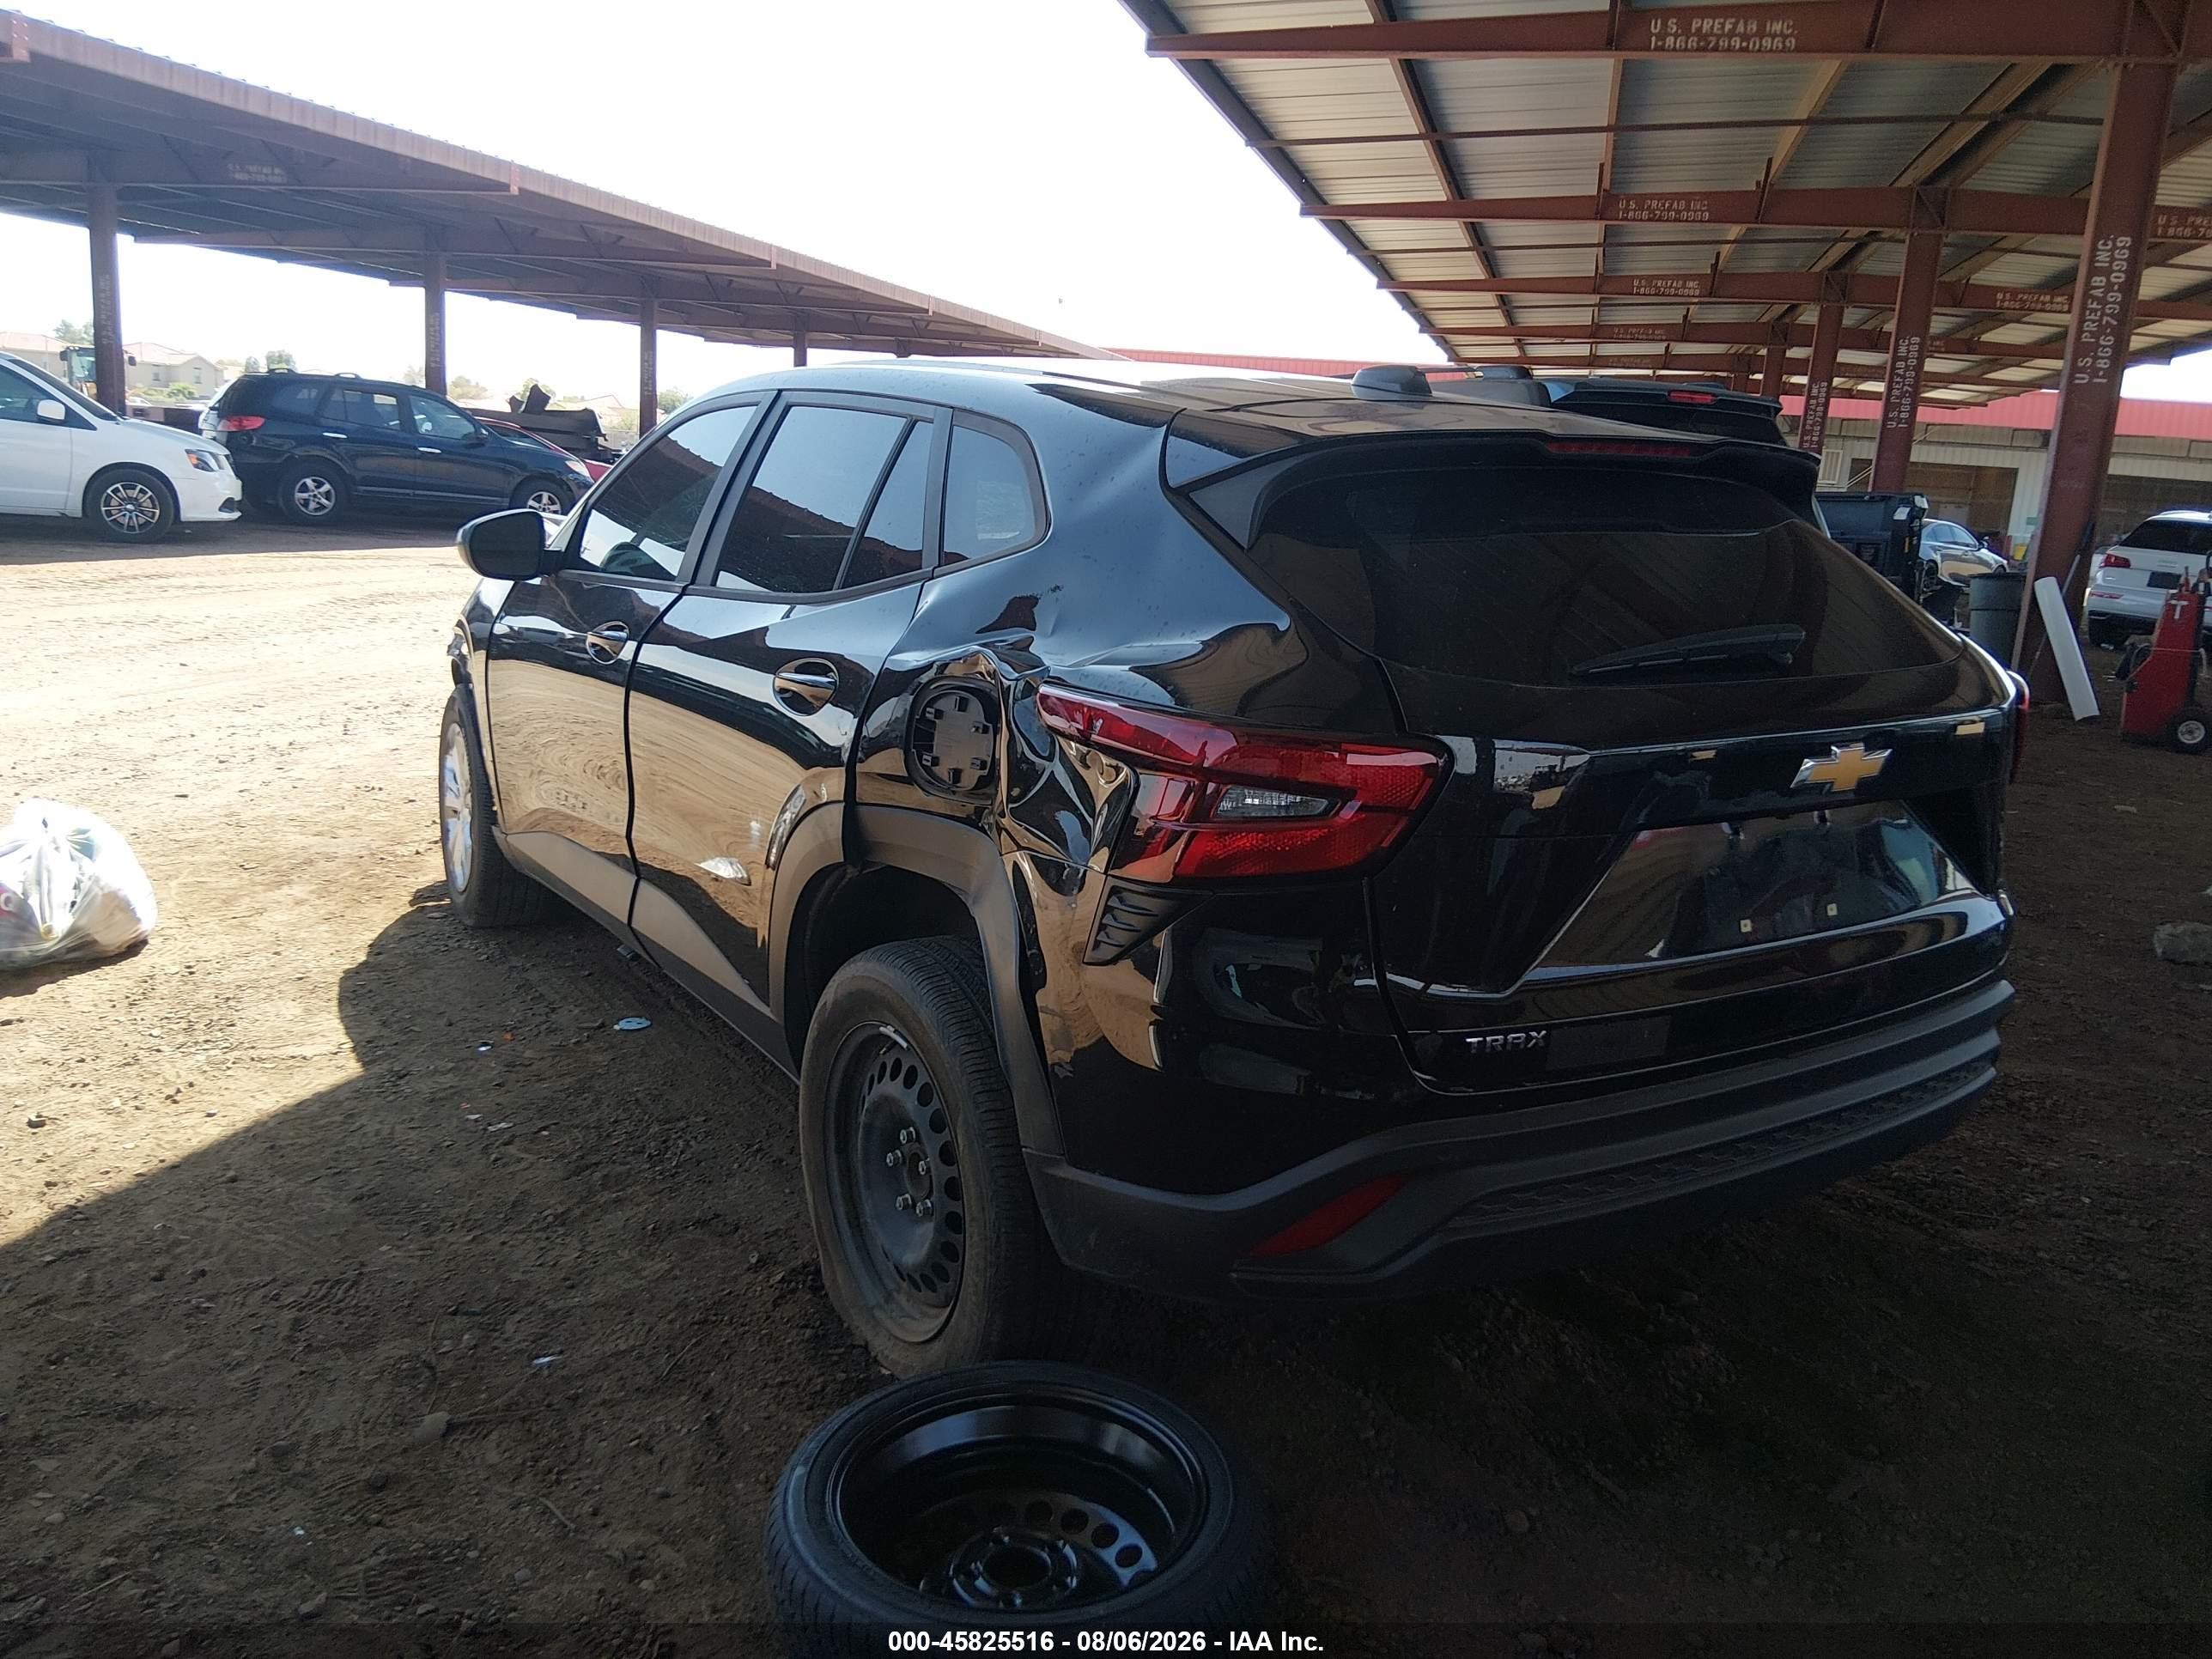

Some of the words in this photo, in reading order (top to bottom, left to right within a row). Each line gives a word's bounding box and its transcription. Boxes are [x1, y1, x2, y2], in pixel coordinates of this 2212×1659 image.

[1691, 18, 1758, 35] PREFAB
[1765, 20, 1798, 35] INC.
[1650, 35, 1796, 52] 1-866-799-0969
[1644, 199, 1686, 210] PREFAB
[2094, 234, 2115, 268] INC.
[2081, 276, 2107, 343] PREFAB
[2093, 236, 2132, 384] 1-866-799-0969
[1897, 336, 1910, 356] INC.
[1890, 362, 1906, 403] PREFAB
[1898, 337, 1921, 428] 1-866-799-0969
[2074, 352, 2094, 385] U.S.
[1887, 407, 1899, 428] U.S.
[1466, 1030, 1547, 1054] TRAX
